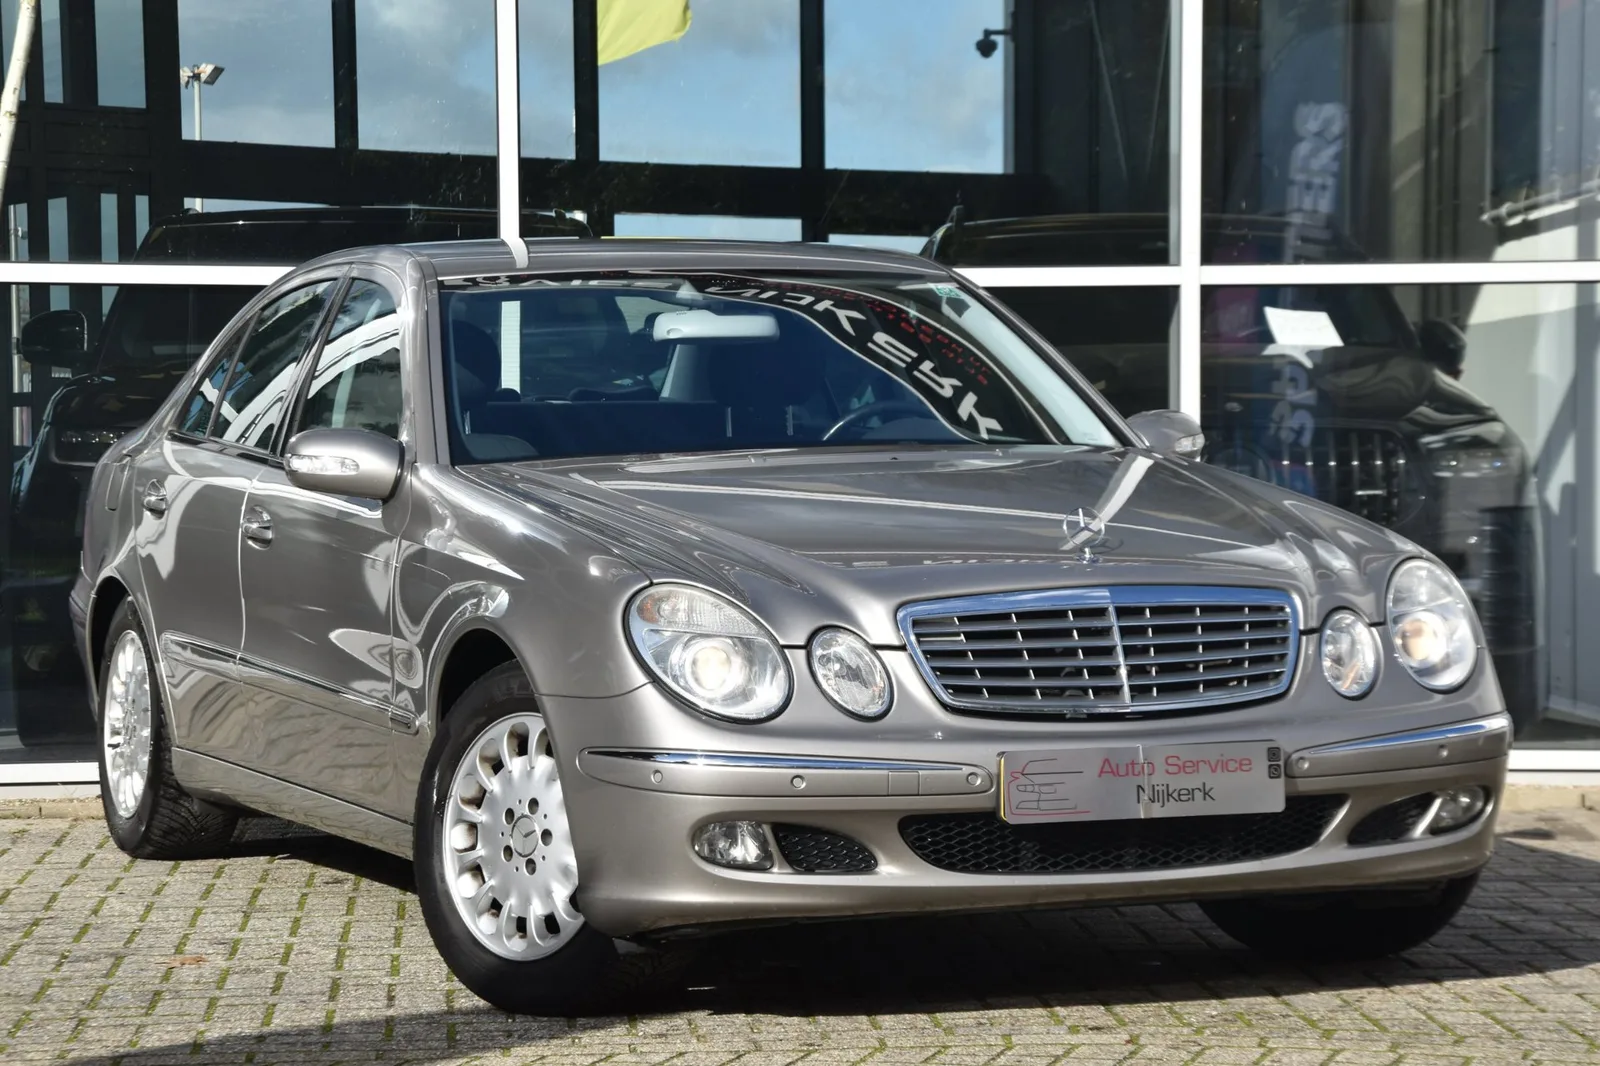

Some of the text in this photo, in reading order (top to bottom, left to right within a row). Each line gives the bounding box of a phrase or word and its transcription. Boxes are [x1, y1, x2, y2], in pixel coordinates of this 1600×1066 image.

[1097, 753, 1253, 778] Auto Service
[1136, 781, 1216, 808] Nijkerk
